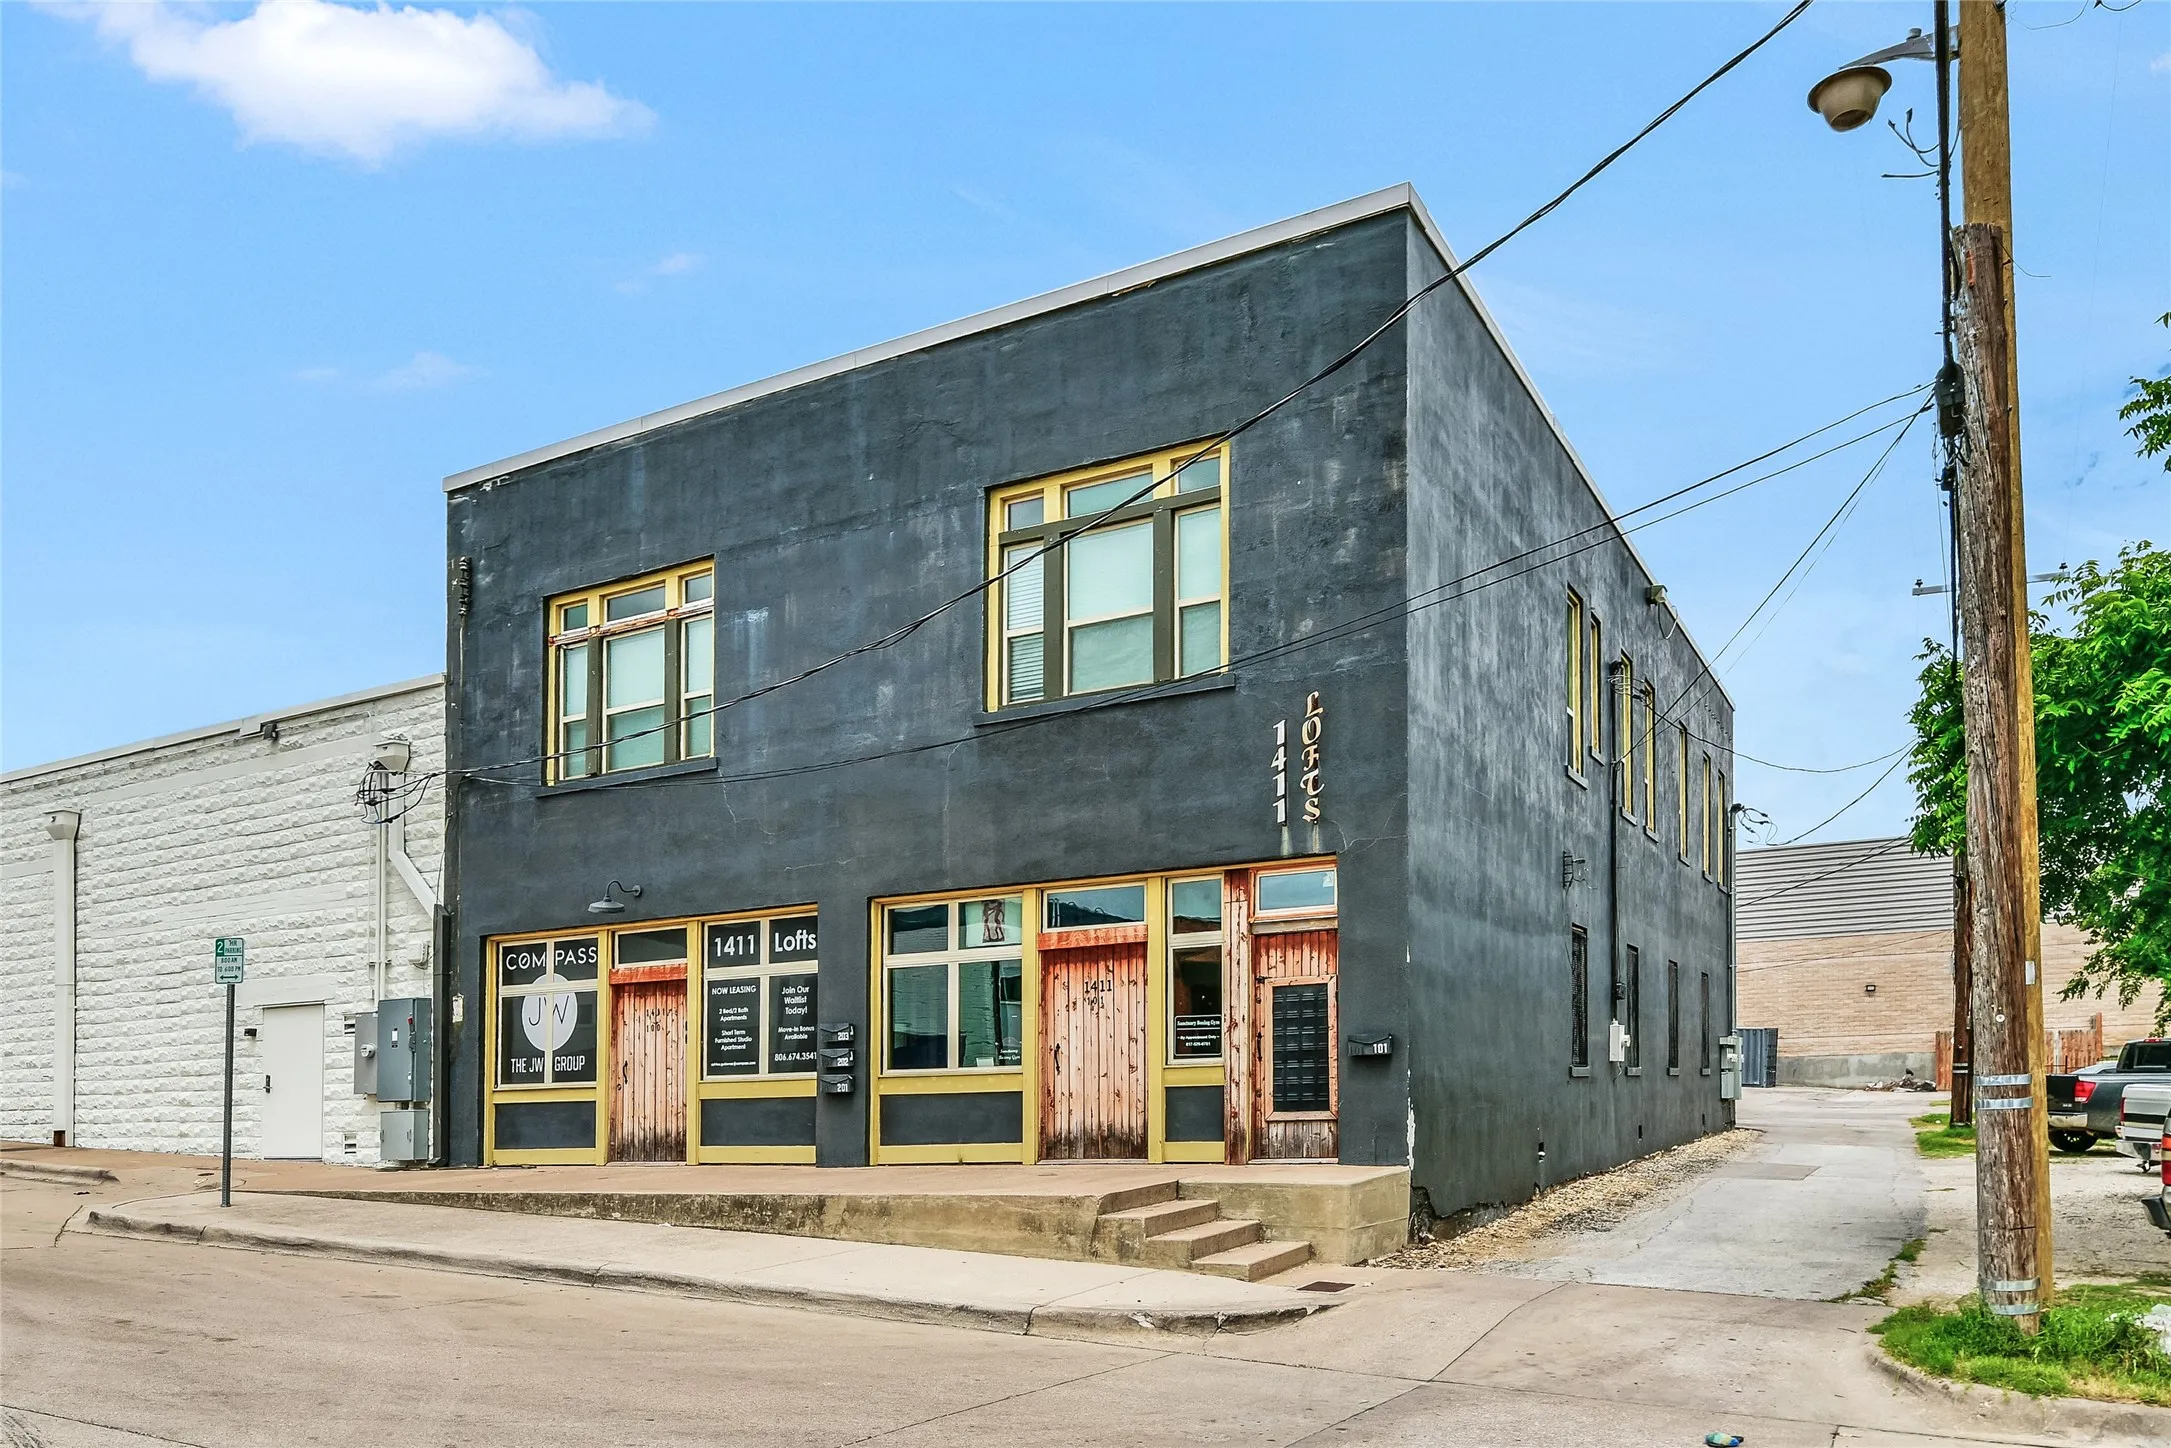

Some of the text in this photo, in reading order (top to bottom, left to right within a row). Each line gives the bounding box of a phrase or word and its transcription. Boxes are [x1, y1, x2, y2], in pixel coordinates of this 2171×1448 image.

[1300, 690, 1325, 823] LOFTS
[1270, 719, 1287, 824] 1411
[217, 941, 223, 953] 2
[714, 929, 817, 957] 1411 Lofts
[712, 985, 757, 995] NOW LEASING
[1085, 979, 1112, 994] 1411
[784, 996, 807, 1004] Waitlist
[785, 1006, 808, 1015] Today!
[837, 1032, 849, 1041] 203
[1372, 1043, 1388, 1054] 101
[774, 1052, 817, 1061] 806.674.3541
[837, 1057, 849, 1066] 202
[511, 1055, 586, 1073] THE JW GROUP
[836, 1083, 848, 1092] 201
